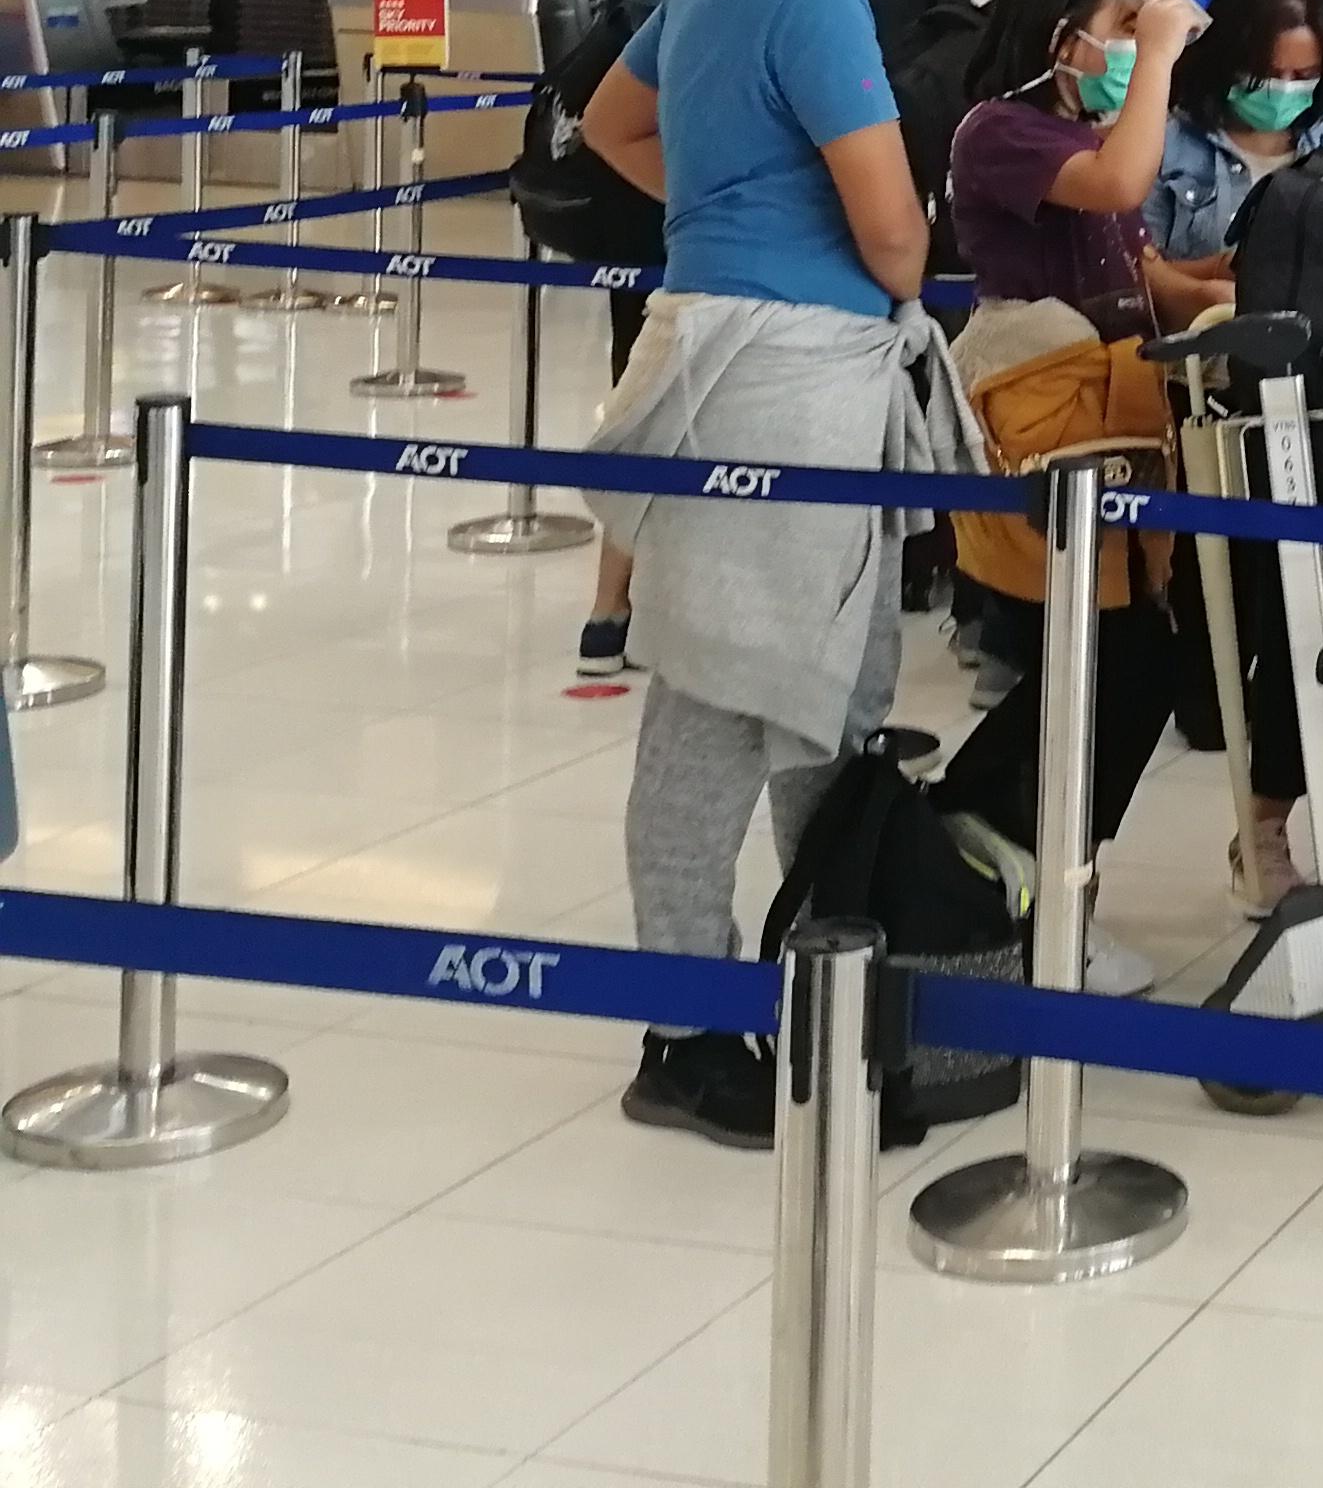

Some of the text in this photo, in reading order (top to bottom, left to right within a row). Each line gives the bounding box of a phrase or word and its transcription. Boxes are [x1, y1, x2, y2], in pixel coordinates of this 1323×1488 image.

[379, 19, 437, 32] PRIORITY
[263, 201, 297, 223] AOT
[116, 217, 154, 236] AOT
[187, 241, 236, 263] AOT
[386, 254, 435, 276] AOT
[590, 266, 642, 289] AOT
[395, 444, 469, 476] AOT
[702, 465, 781, 497] AOT
[1101, 492, 1151, 523] OT
[428, 945, 561, 999] AOT
